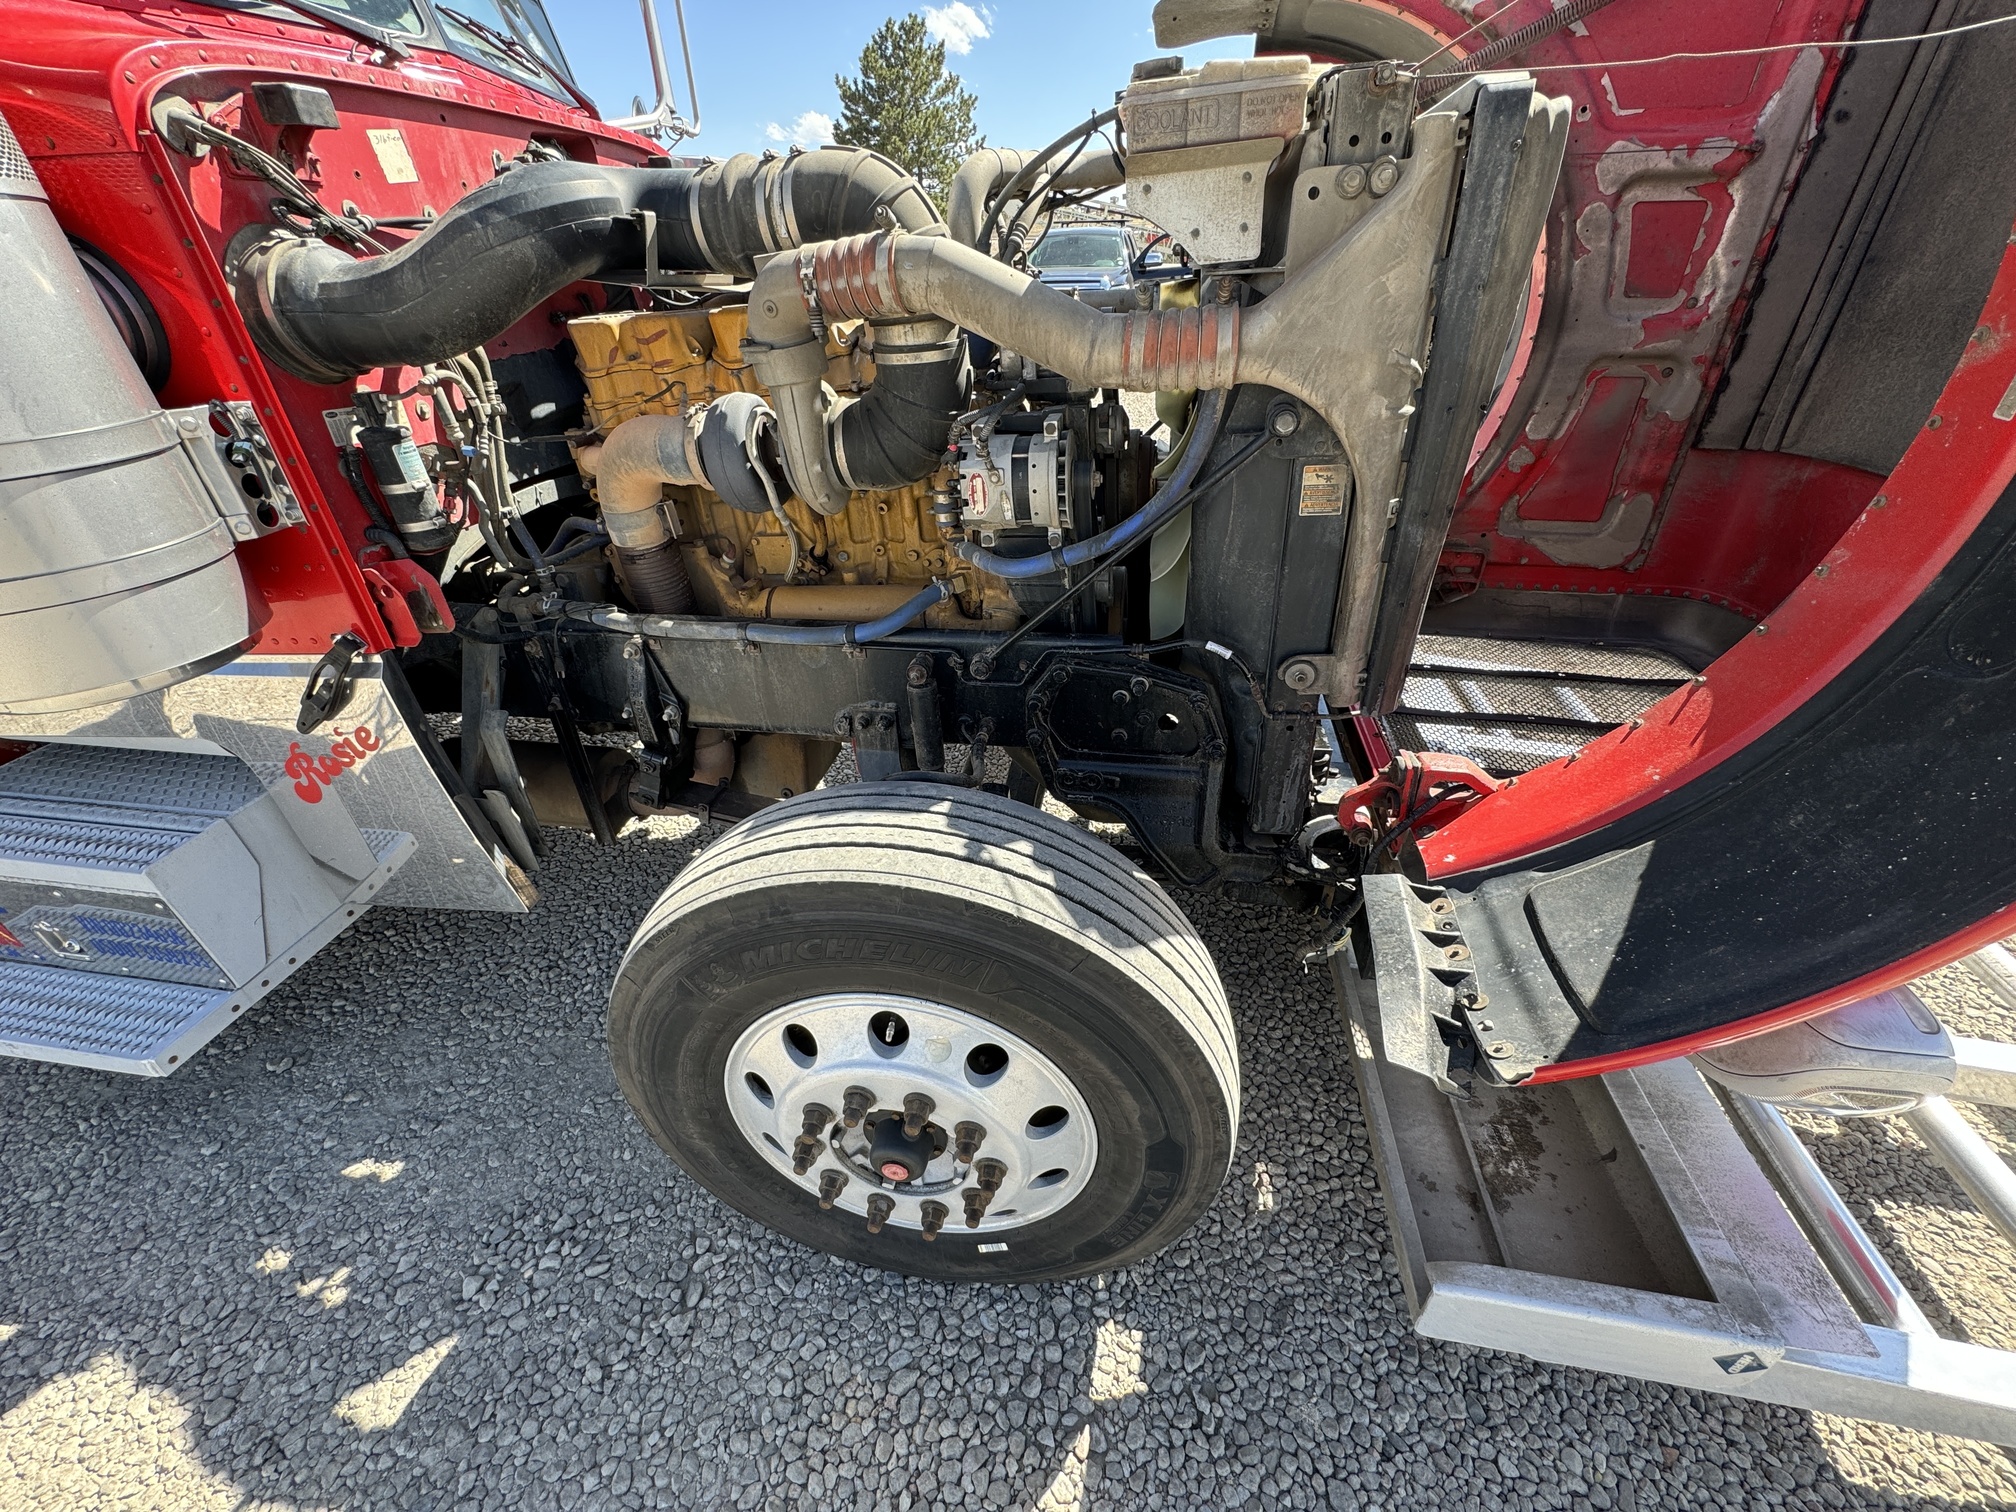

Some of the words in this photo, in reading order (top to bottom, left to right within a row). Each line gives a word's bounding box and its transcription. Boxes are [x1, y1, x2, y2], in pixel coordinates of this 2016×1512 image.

[1136, 104, 1215, 131] COOLANT
[285, 725, 380, 803] Rosie
[739, 938, 984, 979] MICHELIN
[1141, 1193, 1169, 1212] X
[1110, 1212, 1154, 1248] LINE
